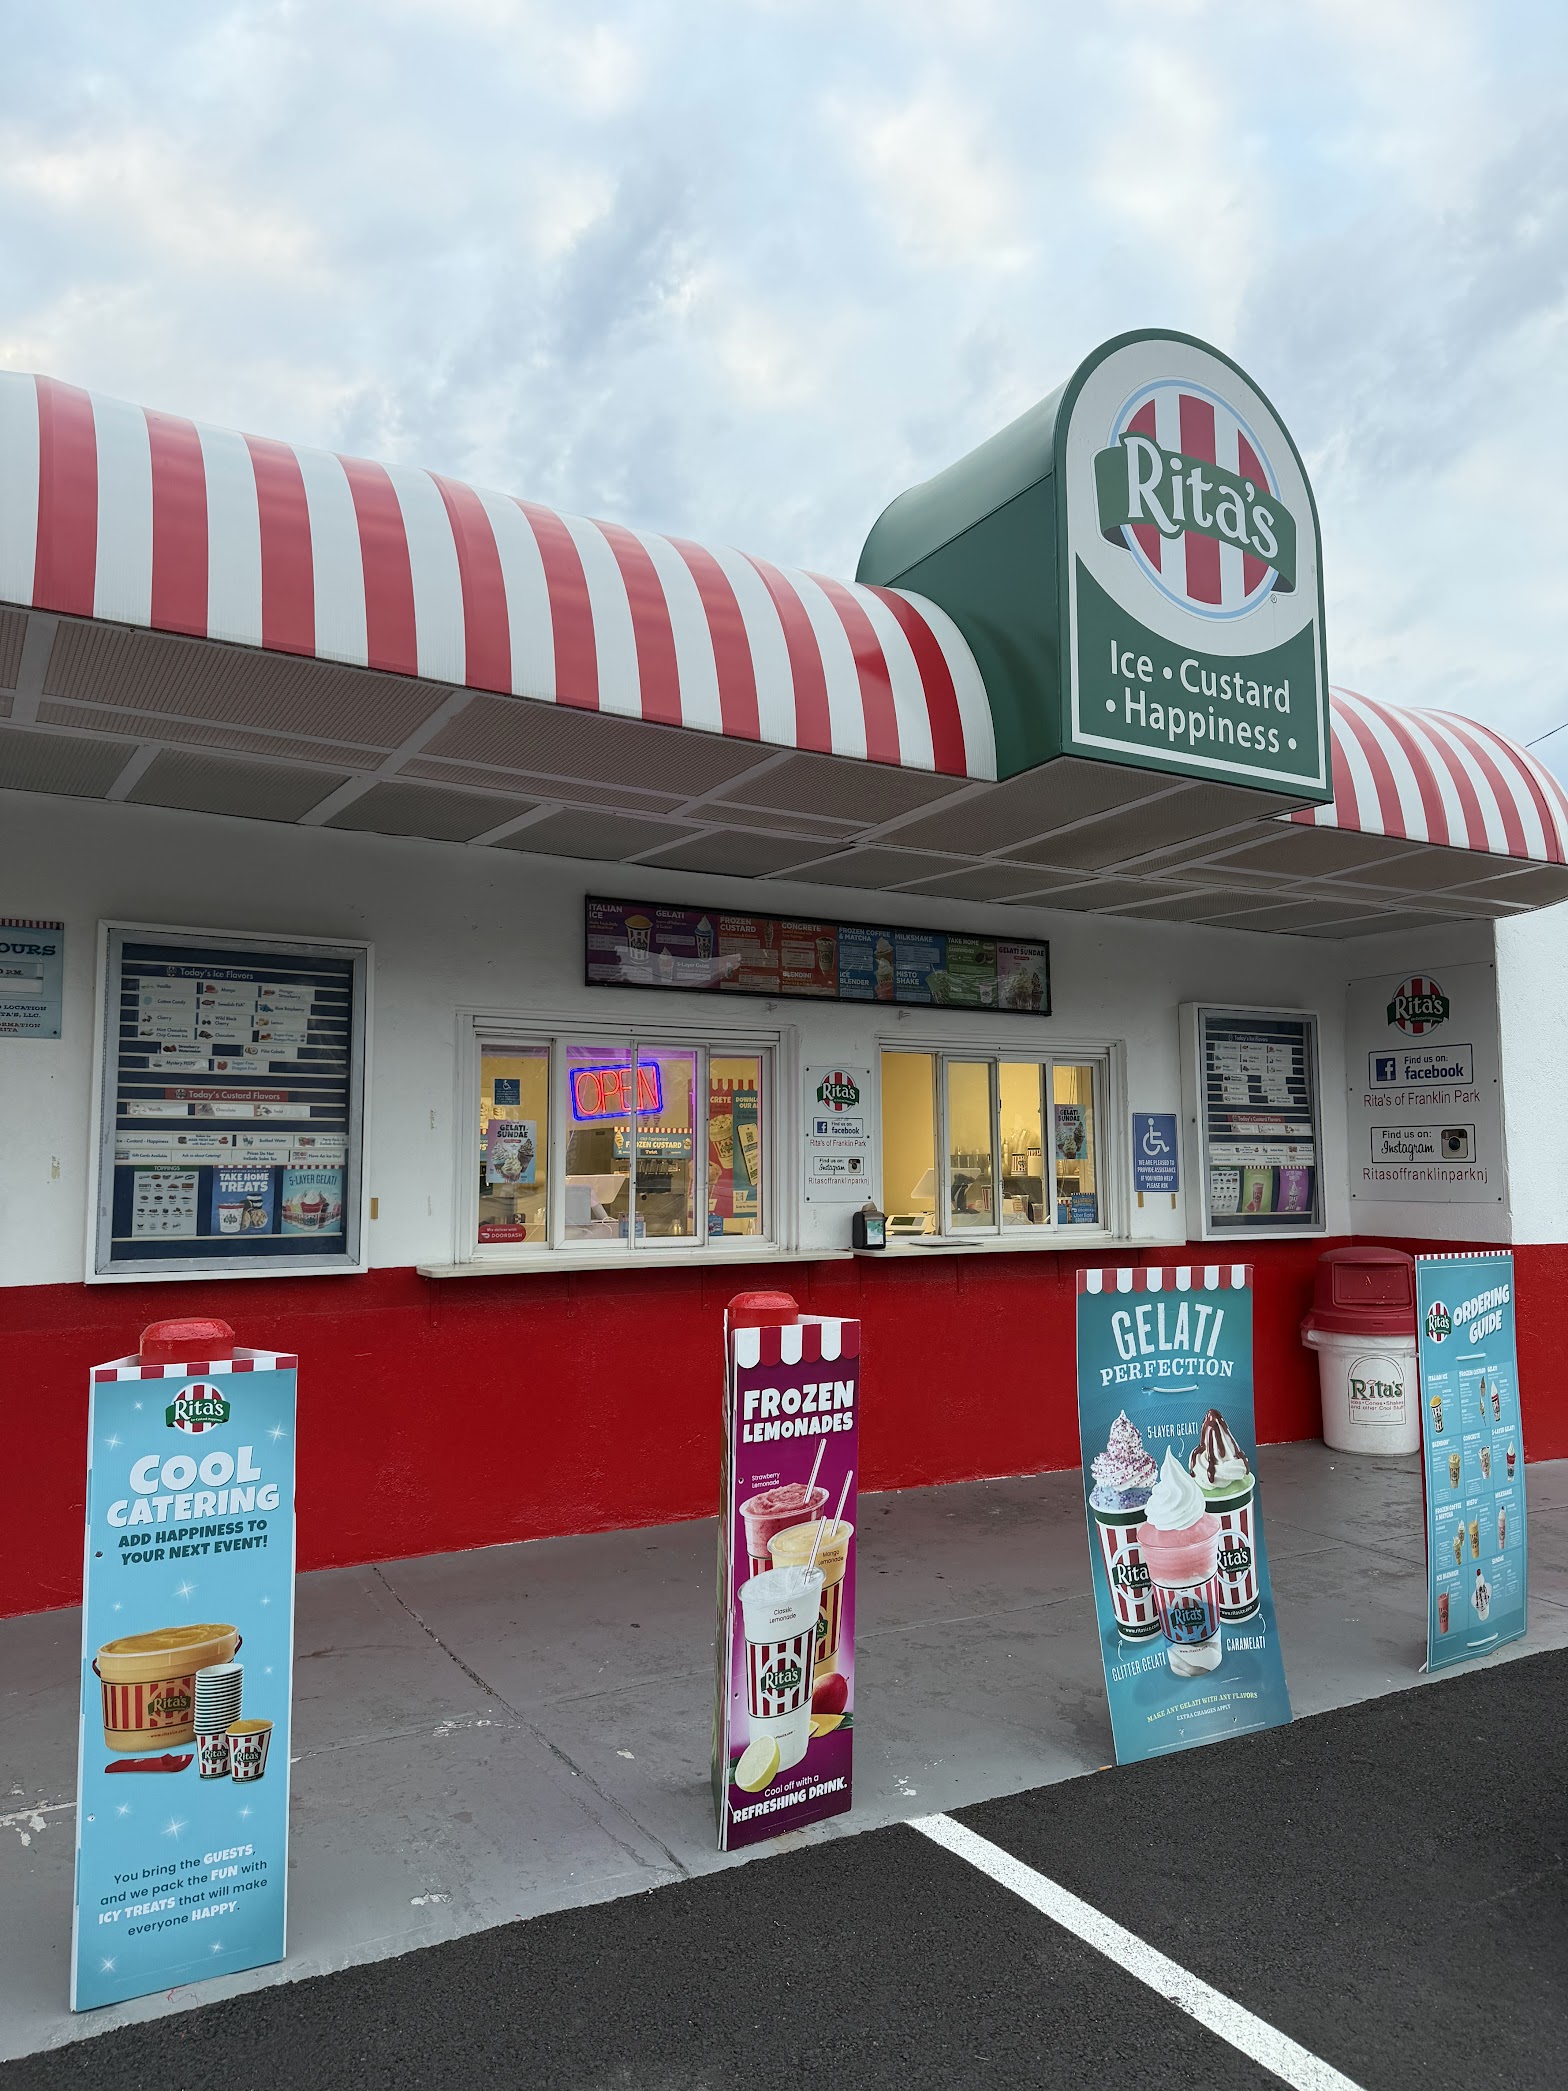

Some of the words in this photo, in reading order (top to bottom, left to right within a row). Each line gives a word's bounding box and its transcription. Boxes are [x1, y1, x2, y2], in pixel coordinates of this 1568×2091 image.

[1125, 436, 1279, 558] Rita's
[1110, 640, 1153, 682] Ice
[1179, 658, 1290, 714] Custard
[1125, 686, 1279, 754] Happiness
[589, 903, 623, 913] ITALIAN
[589, 911, 603, 919] ICE
[655, 910, 685, 919] GELATI
[720, 916, 752, 925] FROZEN
[720, 925, 756, 933] CUSTARD
[781, 922, 822, 932] CONCRETE
[895, 933, 933, 943] MILKSHAKE
[180, 967, 211, 978] Today's
[213, 970, 224, 978] Ice
[226, 971, 254, 980] Flavors
[839, 978, 870, 986] BLENDER
[1394, 994, 1444, 1020] Rita's
[1404, 1056, 1422, 1065] Find
[1435, 1055, 1449, 1063] on:
[1404, 1063, 1464, 1080] facebook
[188, 1091, 220, 1099] Today's
[223, 1091, 251, 1100] Custard
[252, 1091, 281, 1100] Flavors
[575, 1066, 659, 1116] OPEN
[822, 1082, 856, 1100] Rita's
[1364, 1093, 1392, 1108] Rita's
[1394, 1092, 1405, 1107] of
[1408, 1090, 1451, 1106] Franklin
[1454, 1089, 1481, 1103] Park
[831, 1126, 860, 1135] facebook
[1382, 1130, 1402, 1139] Find
[1417, 1130, 1432, 1139] on:
[652, 1141, 682, 1149] CUSTARD
[809, 1139, 825, 1147] Rita's
[825, 1139, 832, 1147] of
[832, 1139, 854, 1147] Franklin
[1381, 1141, 1435, 1161] Instagram
[219, 1173, 242, 1182] TAKE
[243, 1172, 270, 1181] HOME
[818, 1163, 846, 1175] Instagram
[1362, 1167, 1488, 1184] Ritasoffranklinparknj
[220, 1181, 269, 1193] TREATS
[289, 1174, 315, 1186] 5-LAYER
[315, 1174, 338, 1186] GELATI
[1453, 1283, 1510, 1327] ORDERING
[1111, 1302, 1225, 1360] GELATI
[1427, 1314, 1450, 1331] Rita's
[1469, 1309, 1503, 1345] GUIDE
[1100, 1358, 1234, 1387] PERFECTION
[1350, 1378, 1403, 1401] Rita's
[743, 1380, 855, 1421] FROZEN
[174, 1399, 224, 1421] Rita's
[743, 1411, 854, 1444] LEMONADES
[1147, 1424, 1175, 1439] 5-LAYER
[1176, 1421, 1199, 1436] GELATI
[129, 1445, 262, 1495] COOL
[751, 1471, 781, 1482] Strawberry
[751, 1478, 780, 1489] Lemonade
[106, 1483, 280, 1528] CATERING
[118, 1533, 152, 1548] ADD
[155, 1521, 244, 1544] HAPPINESS
[247, 1519, 268, 1532] TO
[121, 1547, 165, 1565] YOUR
[169, 1542, 210, 1560] NEXT
[214, 1535, 268, 1554] EVENT!
[822, 1549, 840, 1558] Mango
[818, 1555, 844, 1566] Lemonade
[769, 1613, 797, 1624] Lemonade
[773, 1606, 793, 1616] Classic
[1173, 1608, 1203, 1625] Rita's
[1226, 1635, 1266, 1651] CARAMELATI
[1111, 1661, 1141, 1682] GLITTER
[1142, 1651, 1167, 1672] GELATI
[765, 1668, 799, 1689] Rita's
[153, 1696, 187, 1712] Rita's
[1146, 1710, 1166, 1723] MAKE
[1166, 1704, 1179, 1715] ANY
[1179, 1698, 1201, 1710] GELATI
[1201, 1696, 1218, 1704] WITH
[1218, 1693, 1232, 1701] ANY
[1232, 1692, 1258, 1700] FLAVORS
[1176, 1712, 1194, 1721] EXTRA
[1193, 1707, 1217, 1717] CHARGES
[1216, 1703, 1232, 1712] APPLY
[204, 1748, 228, 1759] Rita's
[236, 1751, 259, 1763] Rita's
[764, 1786, 782, 1798] Cool
[783, 1781, 796, 1794] off
[796, 1776, 813, 1789] with
[813, 1775, 820, 1783] a
[732, 1789, 807, 1824] REFRESHING
[808, 1776, 848, 1800] DRINK.
[114, 1871, 139, 1884] You
[142, 1862, 177, 1879] bring
[179, 1858, 201, 1870] the
[203, 1844, 256, 1865] GUESTS,
[100, 1891, 127, 1906] and
[130, 1887, 148, 1899] we
[152, 1878, 184, 1897] pack
[187, 1873, 208, 1886] the
[210, 1865, 238, 1881] FUN
[240, 1860, 268, 1874] with
[98, 1909, 122, 1925] ICY
[124, 1897, 176, 1919] TREATS
[179, 1891, 205, 1906] that
[208, 1885, 230, 1899] will
[232, 1878, 268, 1894] make
[127, 1914, 189, 1936] everyone
[191, 1900, 240, 1922] HAPPY.
